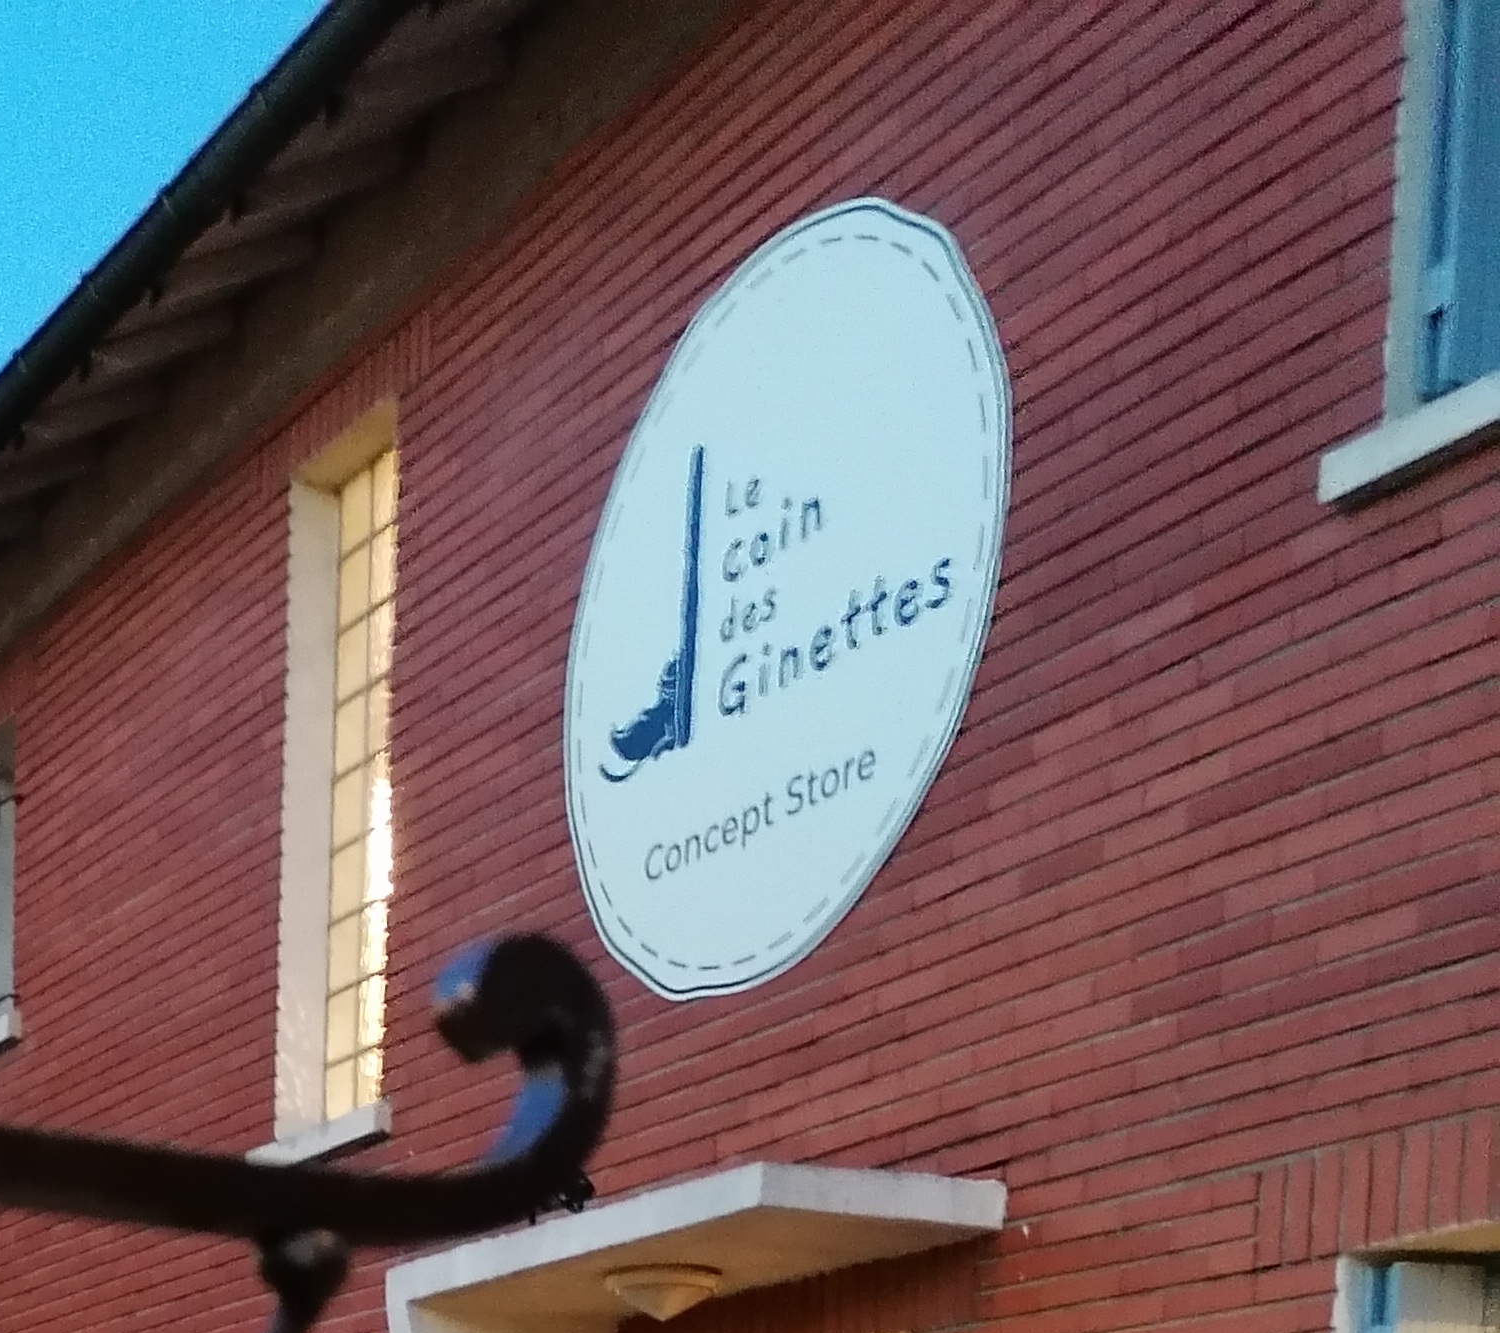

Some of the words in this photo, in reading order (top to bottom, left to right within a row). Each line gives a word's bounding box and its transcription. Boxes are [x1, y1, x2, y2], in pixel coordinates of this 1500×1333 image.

[721, 496, 822, 583] Coin
[724, 477, 761, 517] Le
[716, 557, 953, 717] Ginettes
[719, 587, 777, 643] des
[644, 793, 775, 881] Concept
[785, 748, 877, 816] Store
